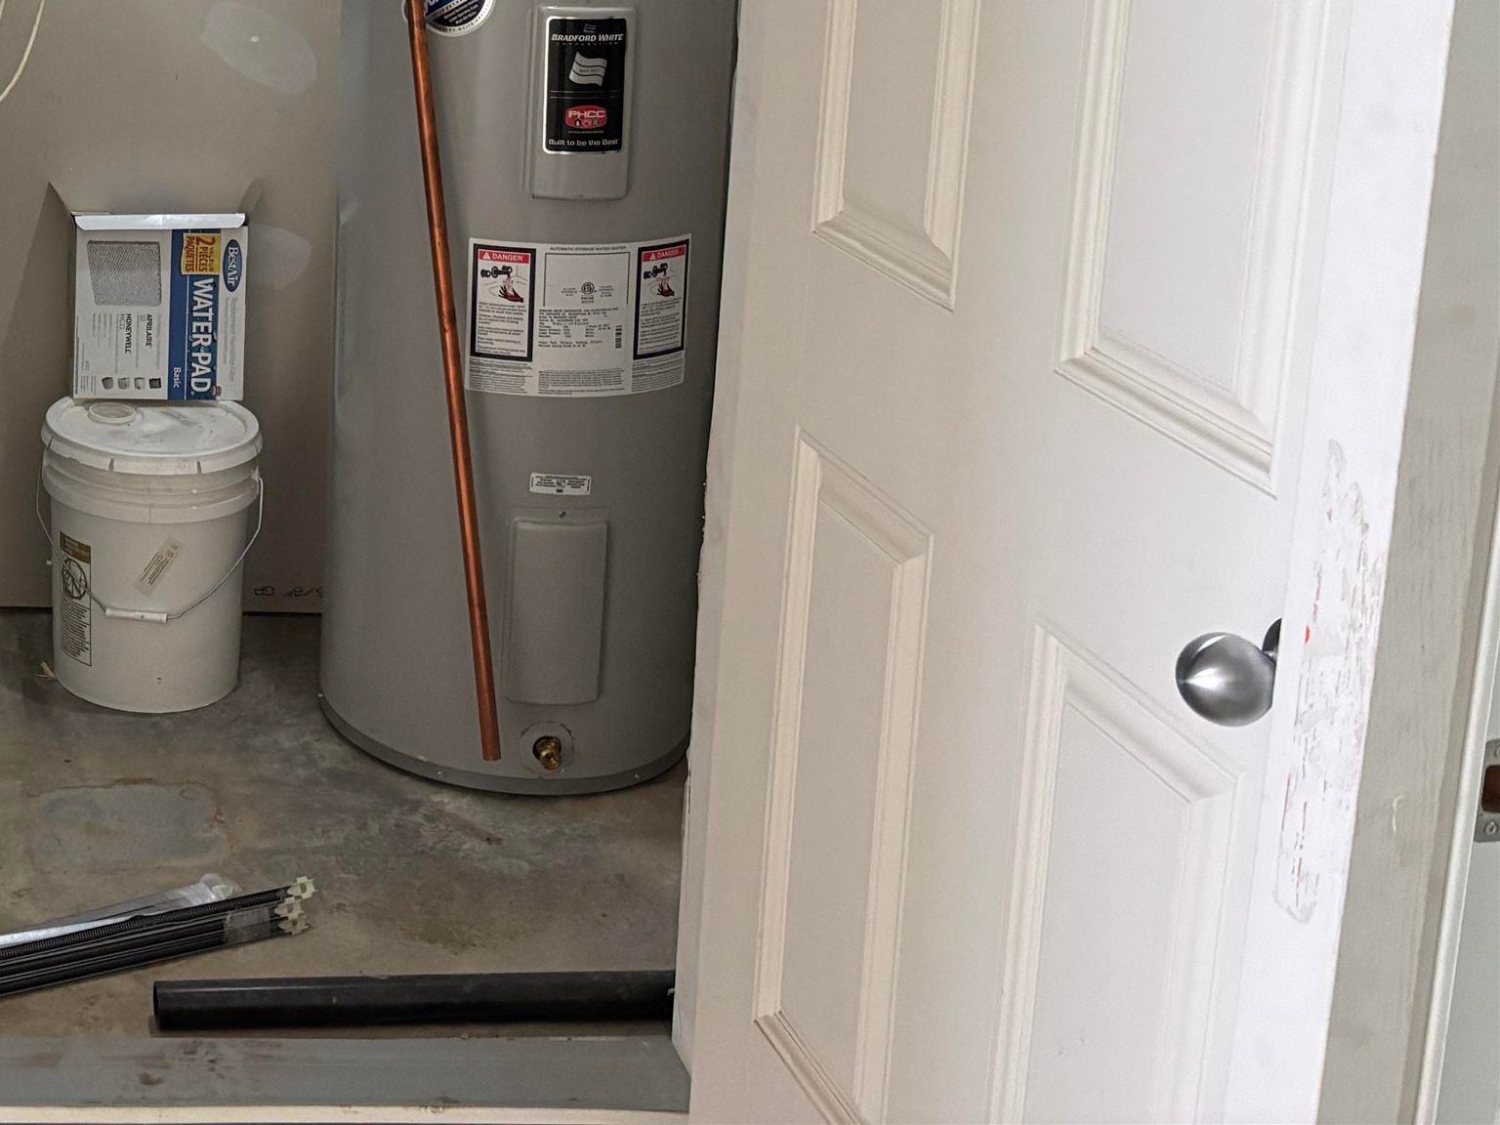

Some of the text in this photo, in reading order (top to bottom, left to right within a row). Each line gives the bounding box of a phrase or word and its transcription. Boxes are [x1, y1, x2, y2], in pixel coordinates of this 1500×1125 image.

[551, 34, 624, 42] BRADFORD WHITE
[568, 110, 607, 118] PHCC
[566, 138, 575, 146] to
[577, 138, 587, 146] be
[588, 138, 600, 146] the
[602, 138, 618, 146] Best
[195, 235, 216, 246] 2
[184, 236, 196, 272] PAQUETES
[492, 253, 524, 263] DANGER
[656, 248, 679, 259] DANGER
[227, 246, 240, 287] BestAir
[173, 367, 182, 388] Basic
